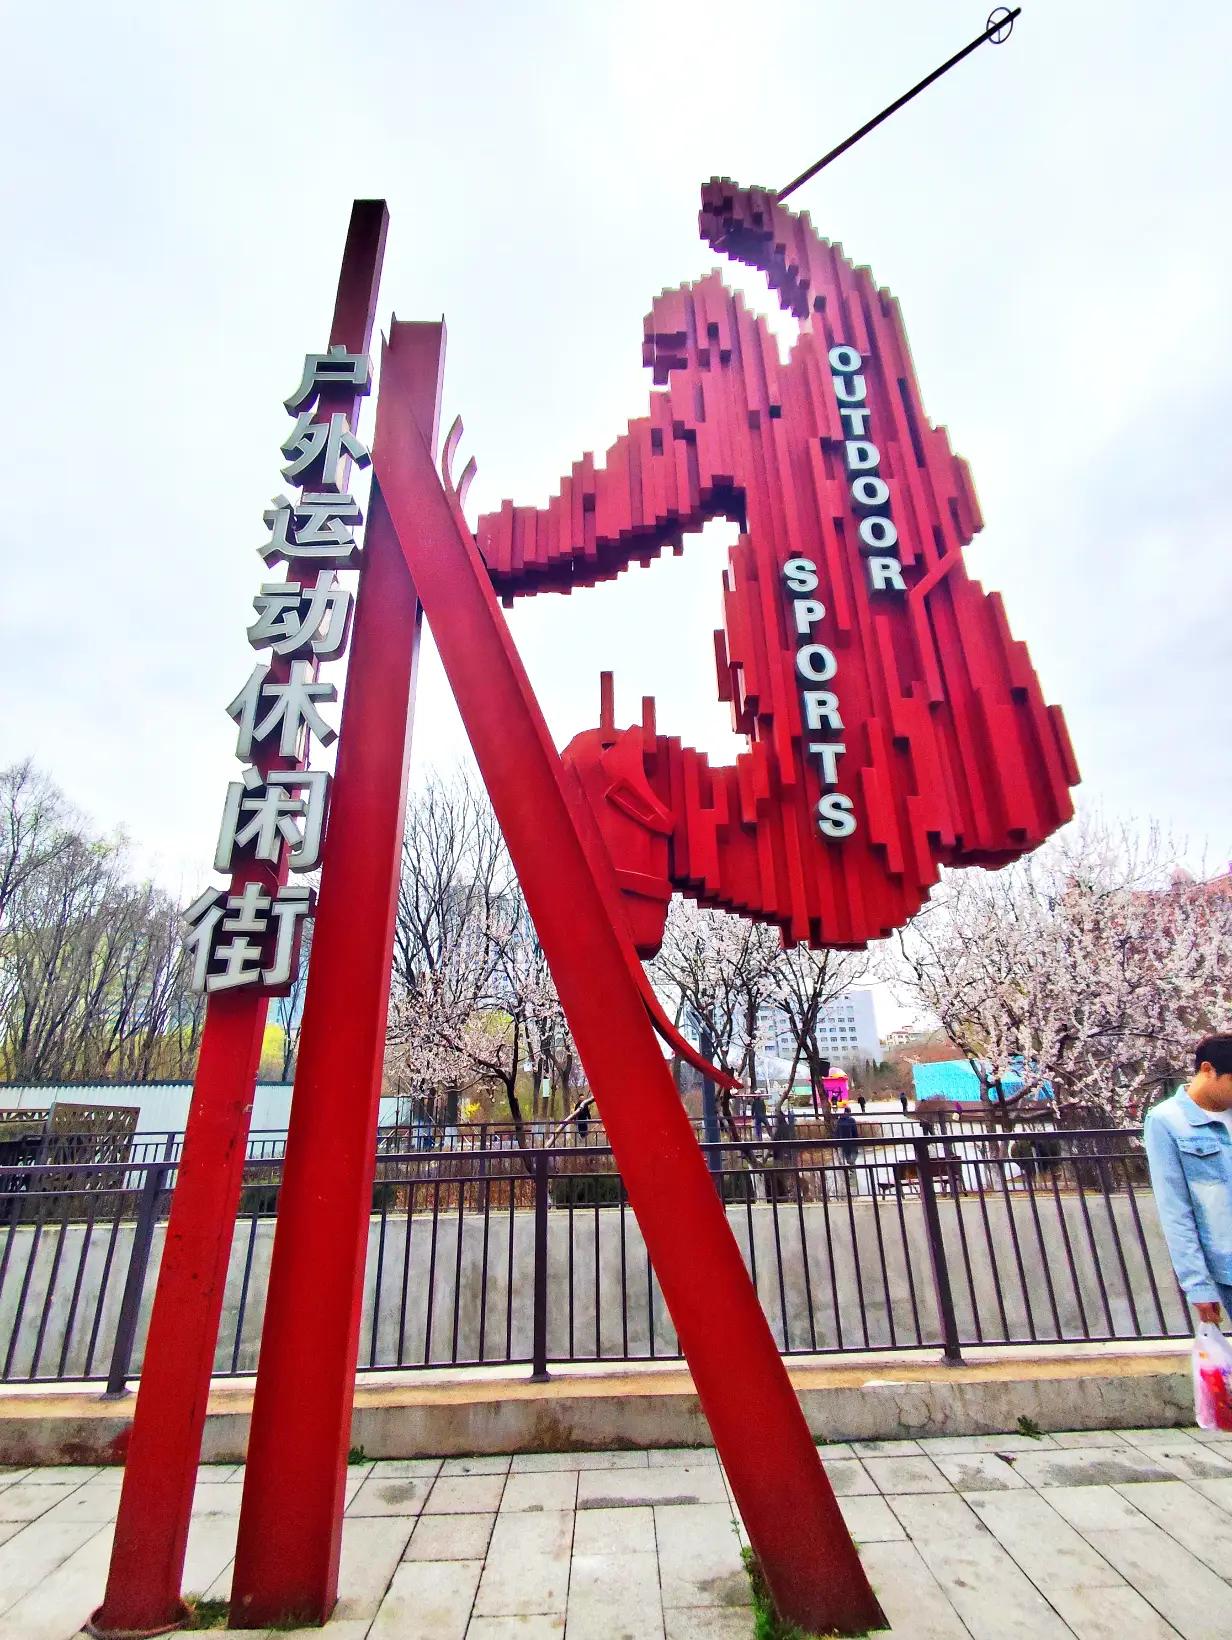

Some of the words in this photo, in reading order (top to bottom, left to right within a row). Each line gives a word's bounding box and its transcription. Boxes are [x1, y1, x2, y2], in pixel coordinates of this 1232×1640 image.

[829, 345, 906, 589] OUTDOOR
[182, 345, 372, 994] 户外运动休闲街
[783, 558, 857, 838] SPORTS
